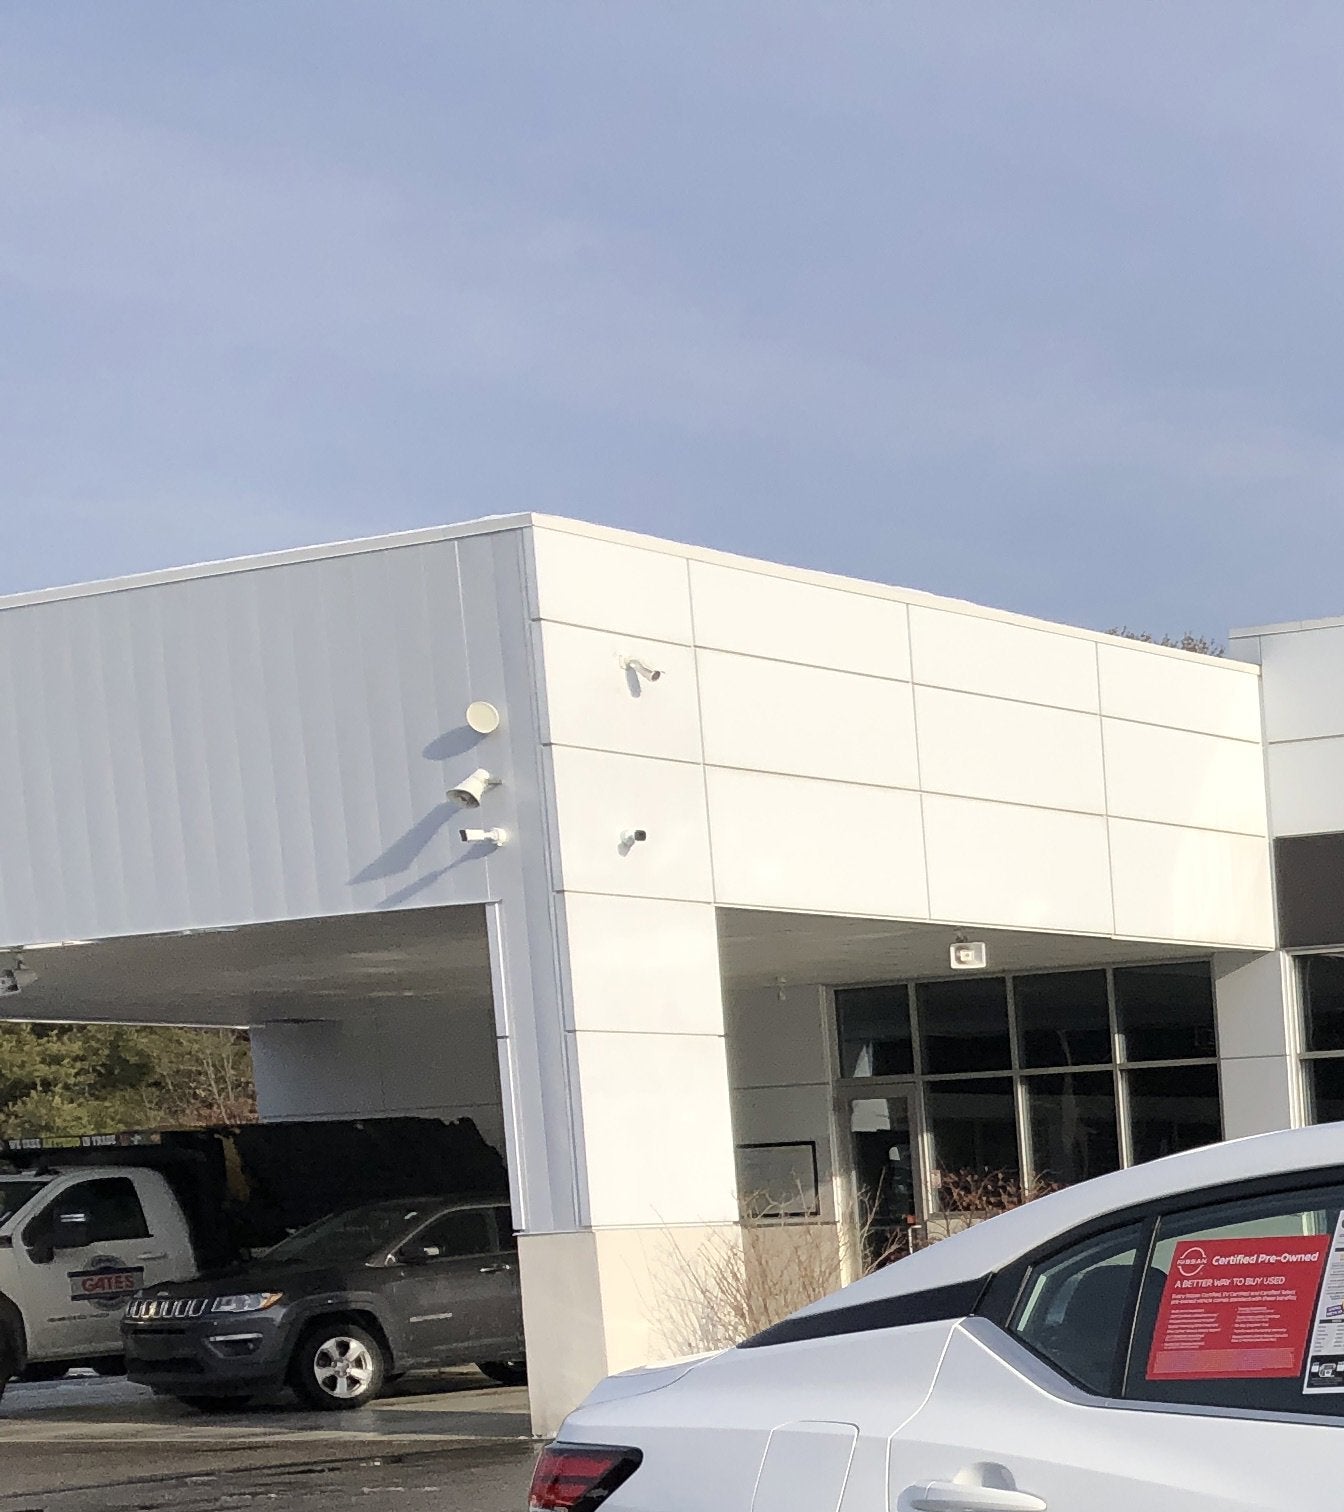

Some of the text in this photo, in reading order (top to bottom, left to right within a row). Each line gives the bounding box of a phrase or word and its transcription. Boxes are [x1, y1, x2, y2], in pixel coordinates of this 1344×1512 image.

[1212, 1251, 1320, 1266] Certified Pre-Owned
[81, 1274, 134, 1293] GATES
[1174, 1276, 1286, 1289] A BETTER WAY TO BUY USED
